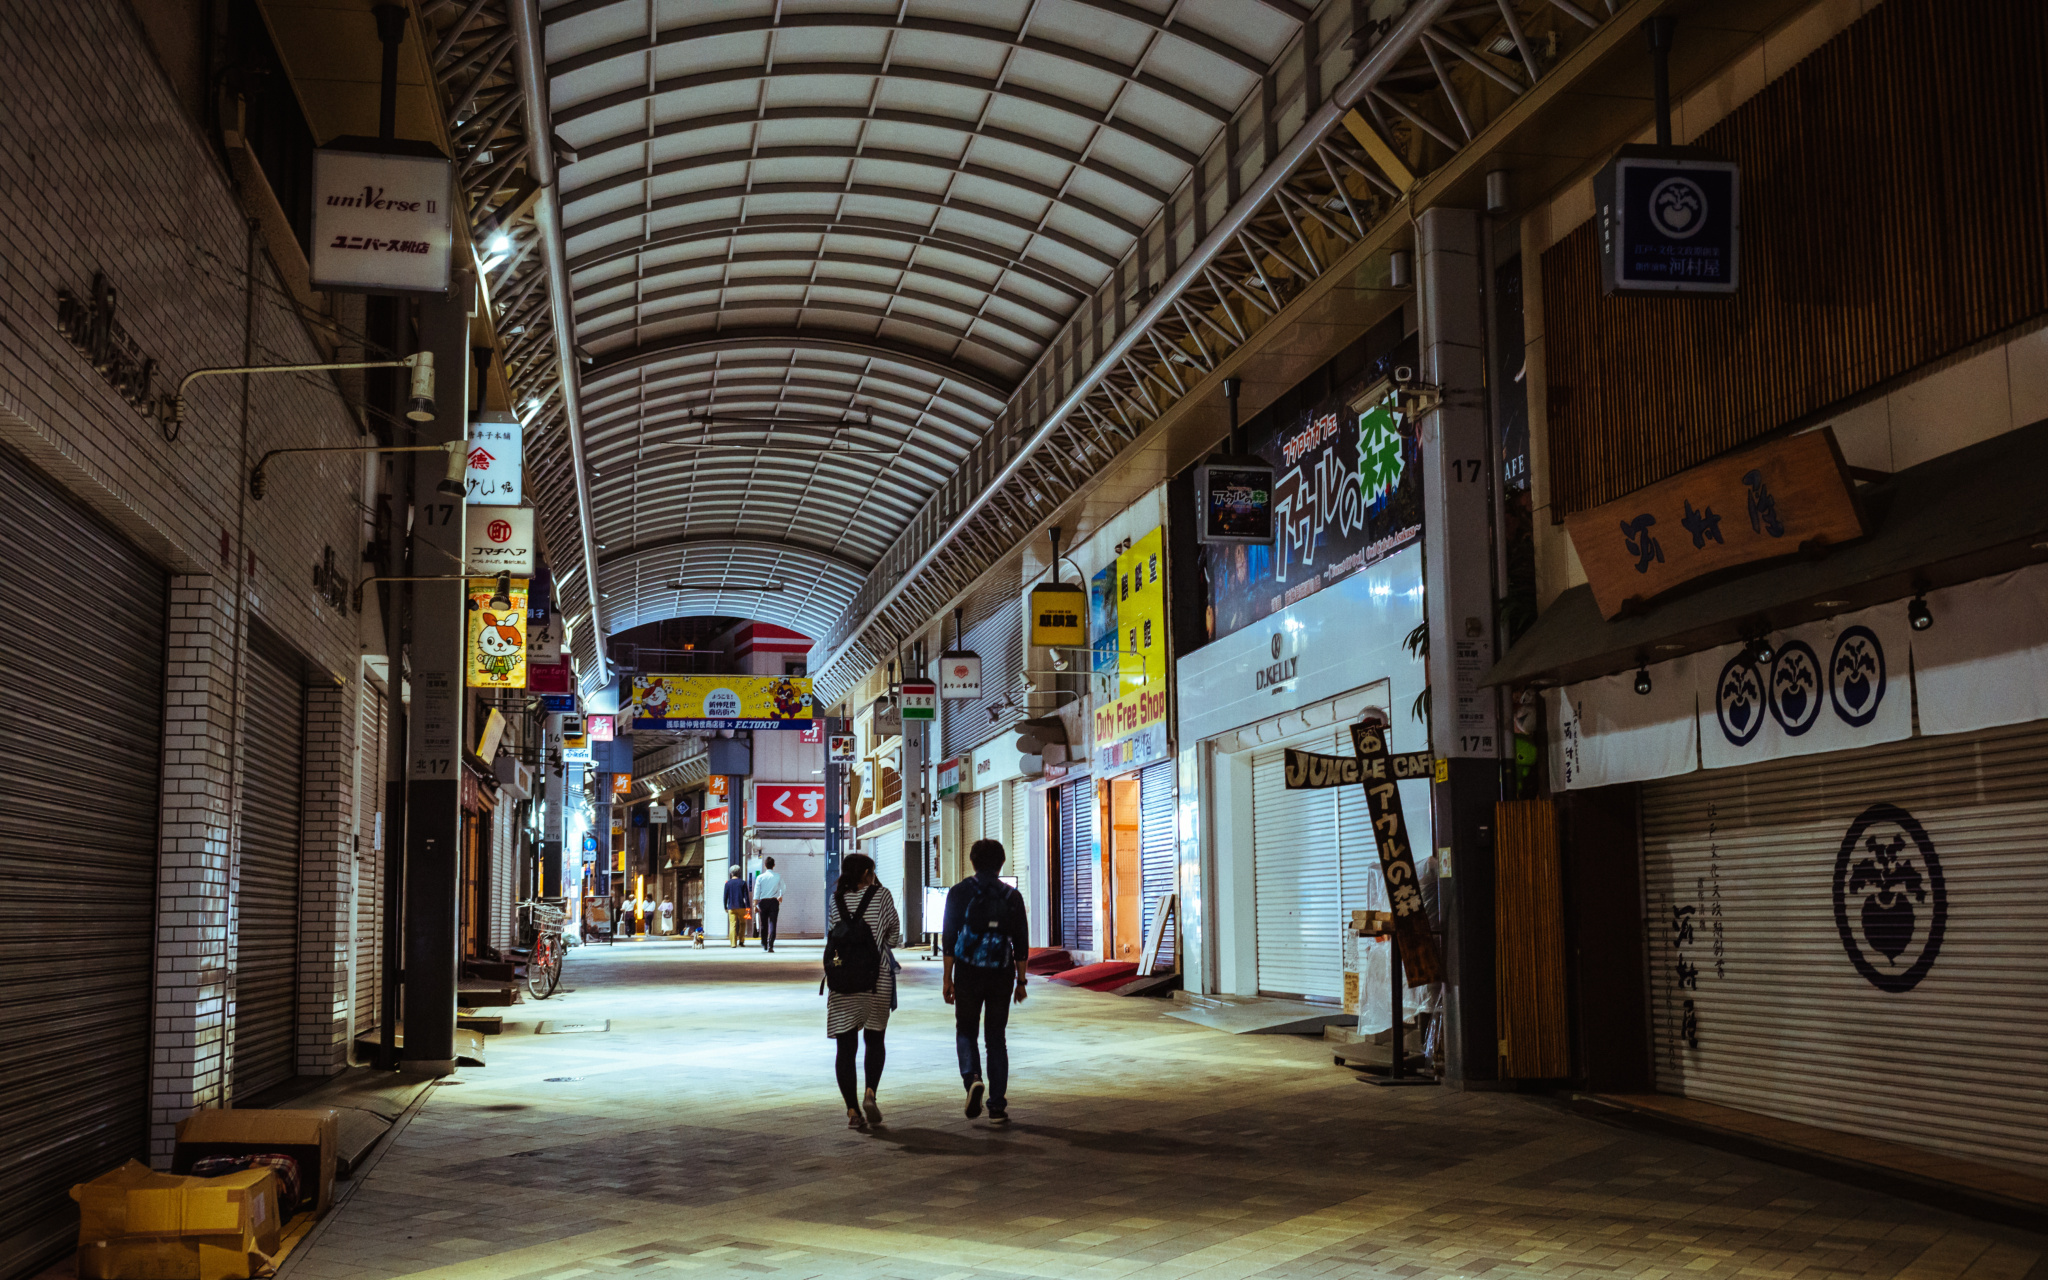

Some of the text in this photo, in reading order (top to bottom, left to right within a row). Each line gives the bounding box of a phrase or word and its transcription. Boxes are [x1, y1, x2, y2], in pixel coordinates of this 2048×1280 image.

[326, 186, 421, 212] uniVerse
[330, 235, 431, 254] ユニバース靴店
[1669, 258, 1721, 277] 河村屋
[1282, 412, 1338, 467] フクロウカフェ
[1452, 459, 1482, 483] 17
[424, 504, 454, 526] 17
[471, 547, 527, 556] コマチヘア
[1256, 655, 1298, 691] D.KELLY
[1096, 690, 1165, 741] Duty Free Shop
[591, 717, 610, 735] 新
[548, 733, 560, 743] 16
[908, 739, 919, 747] 16
[1460, 736, 1480, 752] 17
[430, 759, 450, 773] 17
[1286, 750, 1387, 787] JUNGLE
[615, 776, 629, 790] 新
[711, 776, 726, 791] 新
[1369, 782, 1422, 918] アウルの森
